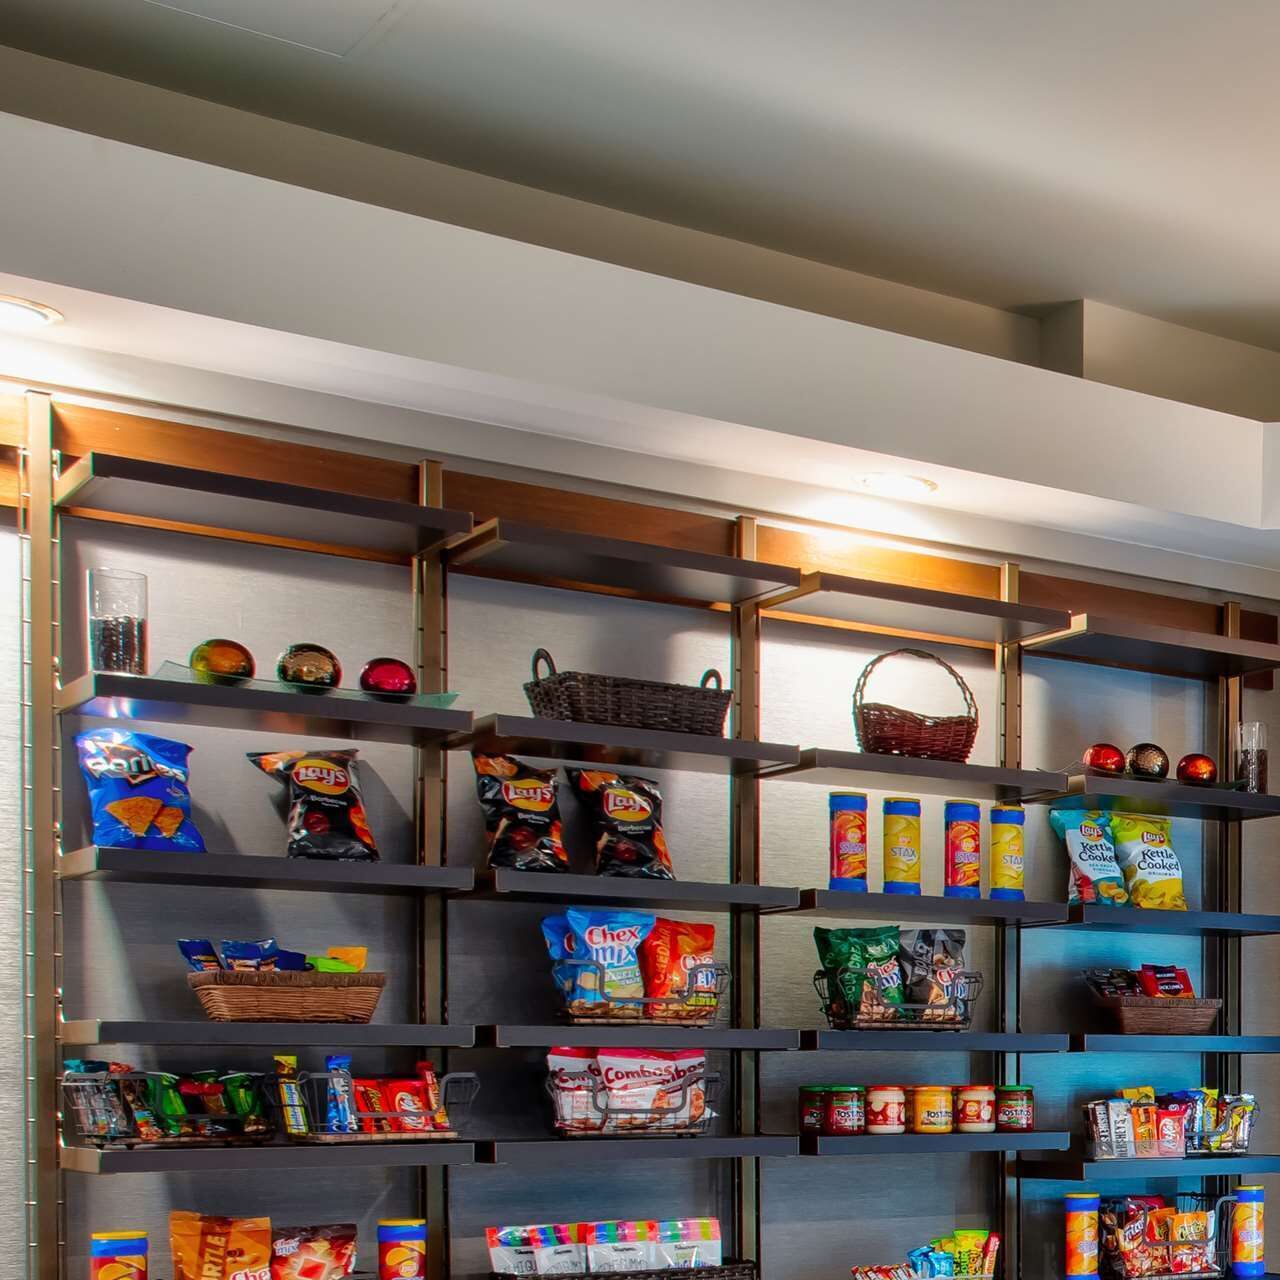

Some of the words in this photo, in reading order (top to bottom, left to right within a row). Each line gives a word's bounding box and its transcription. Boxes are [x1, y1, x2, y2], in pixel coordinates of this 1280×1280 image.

[1081, 842, 1112, 857] Kettle
[1142, 848, 1174, 861] Kettle
[1138, 858, 1179, 871] Cooked
[586, 926, 640, 946] Chex
[604, 1065, 672, 1083] Combos
